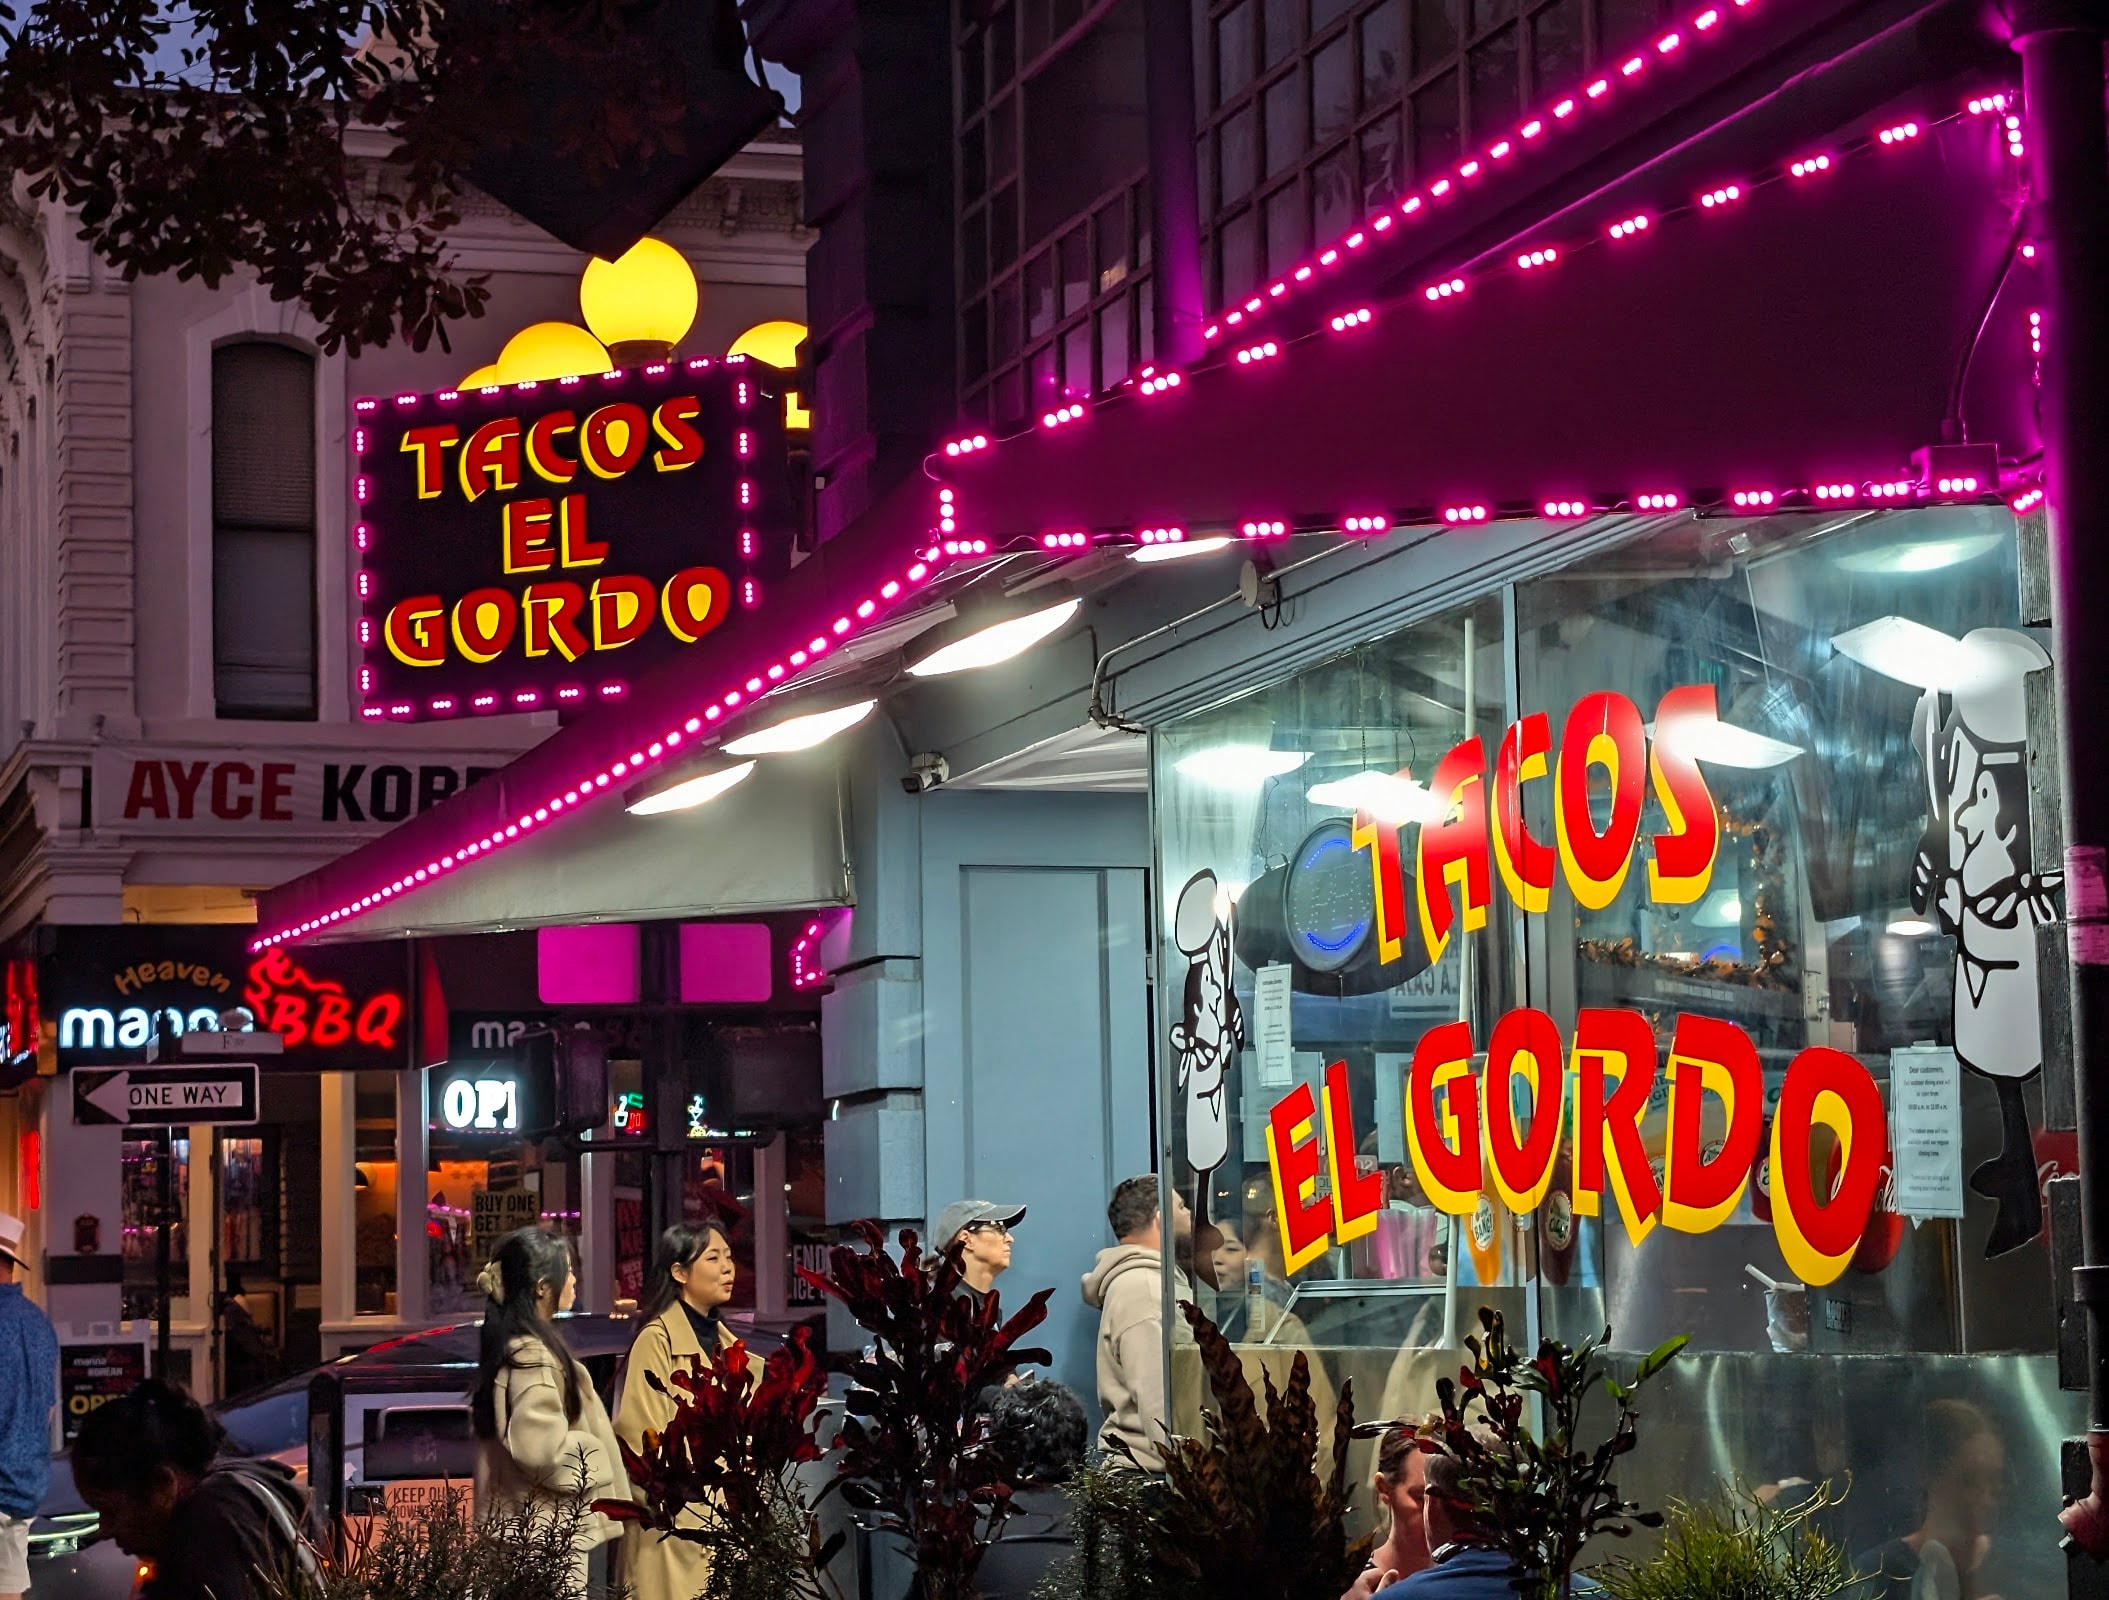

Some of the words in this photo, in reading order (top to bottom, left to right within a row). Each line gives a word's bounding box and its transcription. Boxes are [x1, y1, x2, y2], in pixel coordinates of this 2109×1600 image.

[400, 396, 704, 502] TACOS
[503, 494, 609, 574] EL
[385, 566, 731, 667] GORDO
[124, 760, 296, 820] AYCE
[1351, 684, 1720, 966] TACOS
[113, 960, 232, 996] Heaven
[269, 993, 402, 1048] BBQ
[130, 1086, 172, 1106] ONE
[183, 1084, 227, 1105] WAY
[1265, 1059, 1384, 1277] EL
[1405, 1008, 1887, 1287] GORDO
[475, 1195, 503, 1212] BUY
[507, 1194, 536, 1212] ONE
[393, 1487, 425, 1503] KEEP
